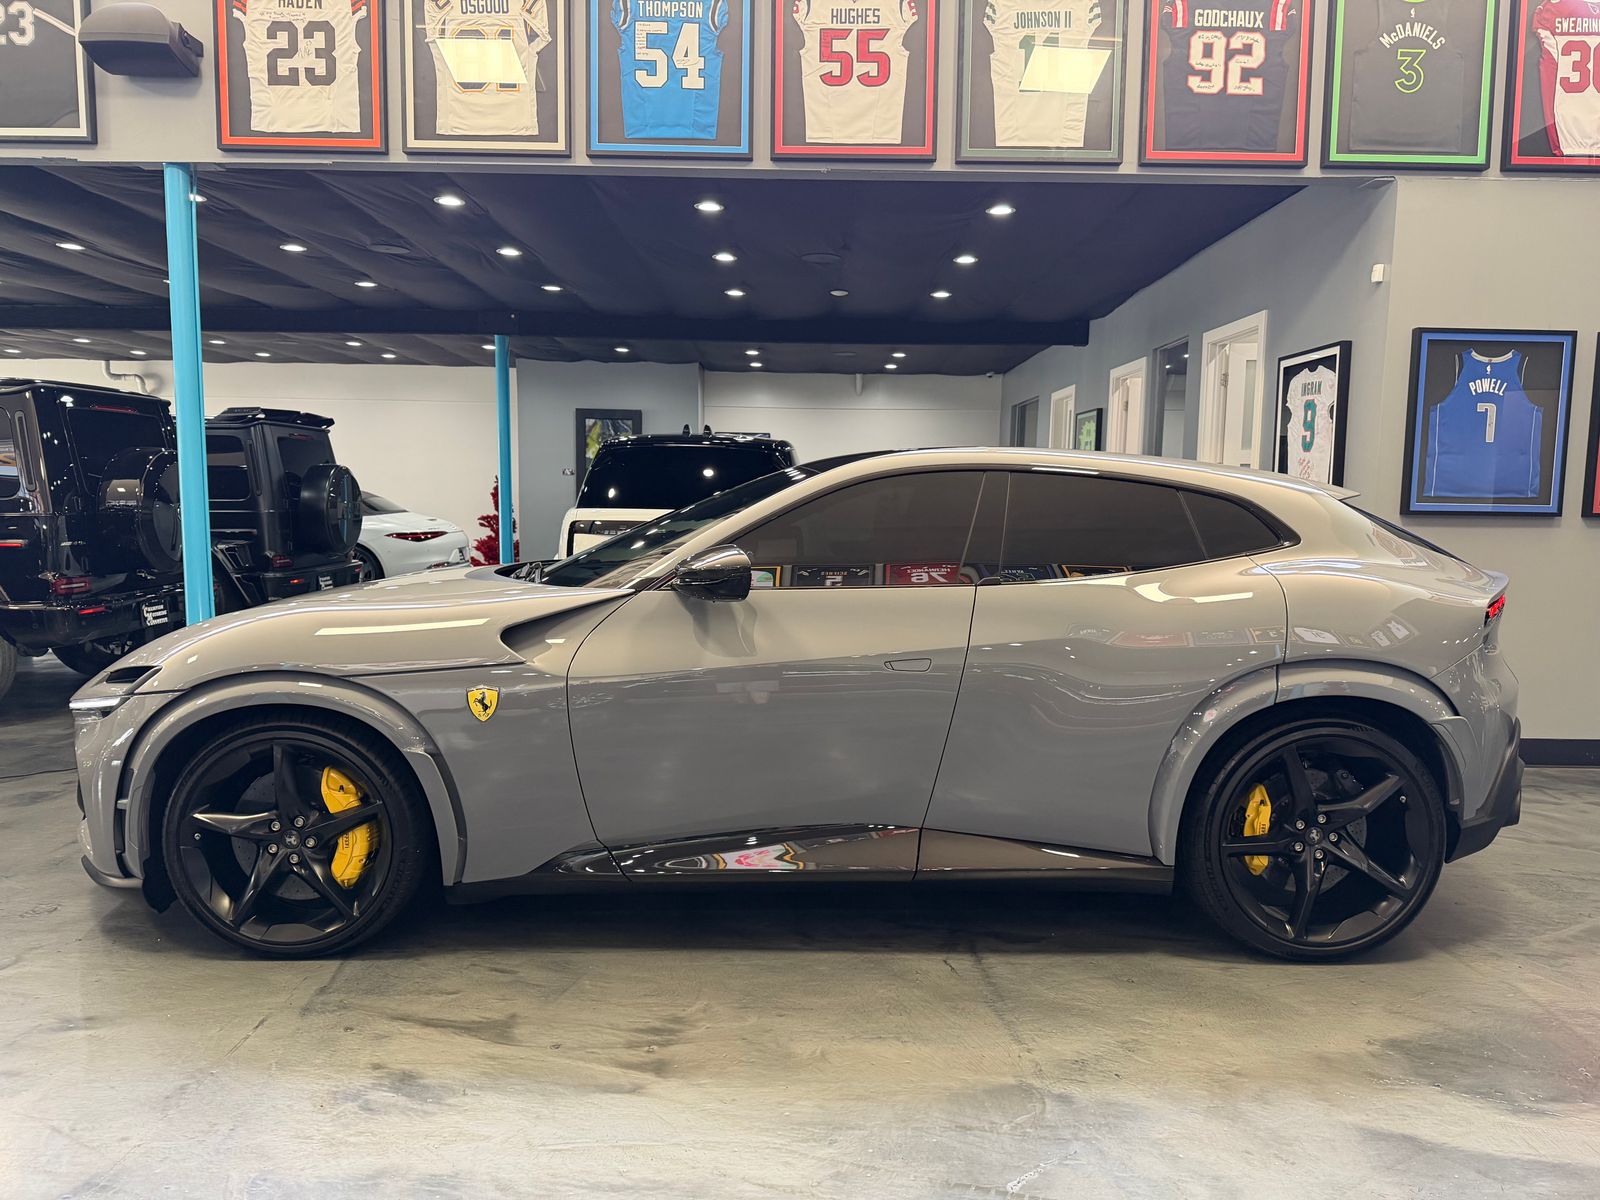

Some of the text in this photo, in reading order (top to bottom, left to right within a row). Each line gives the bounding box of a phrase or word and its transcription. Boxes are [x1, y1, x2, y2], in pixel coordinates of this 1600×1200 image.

[0, 0, 35, 46] 3
[460, 0, 510, 14] OSGOOD
[638, 0, 704, 18] THOMPSON
[831, 8, 881, 24] HUGHES
[1014, 11, 1072, 29] JOHNSON II
[1194, 9, 1265, 29] GODCHAUX
[1379, 22, 1446, 50] McDANIELS
[1555, 17, 1600, 33] SWEARIN
[266, 20, 337, 87] 23
[634, 20, 705, 90] 54
[819, 28, 891, 88] 55
[1187, 30, 1266, 96] 92
[1559, 40, 1600, 94] 3
[1394, 48, 1427, 94] 3
[1300, 380, 1323, 397] INGRAM
[1468, 378, 1508, 396] POWELL
[1301, 398, 1318, 453] 9
[1477, 402, 1497, 443] 7
